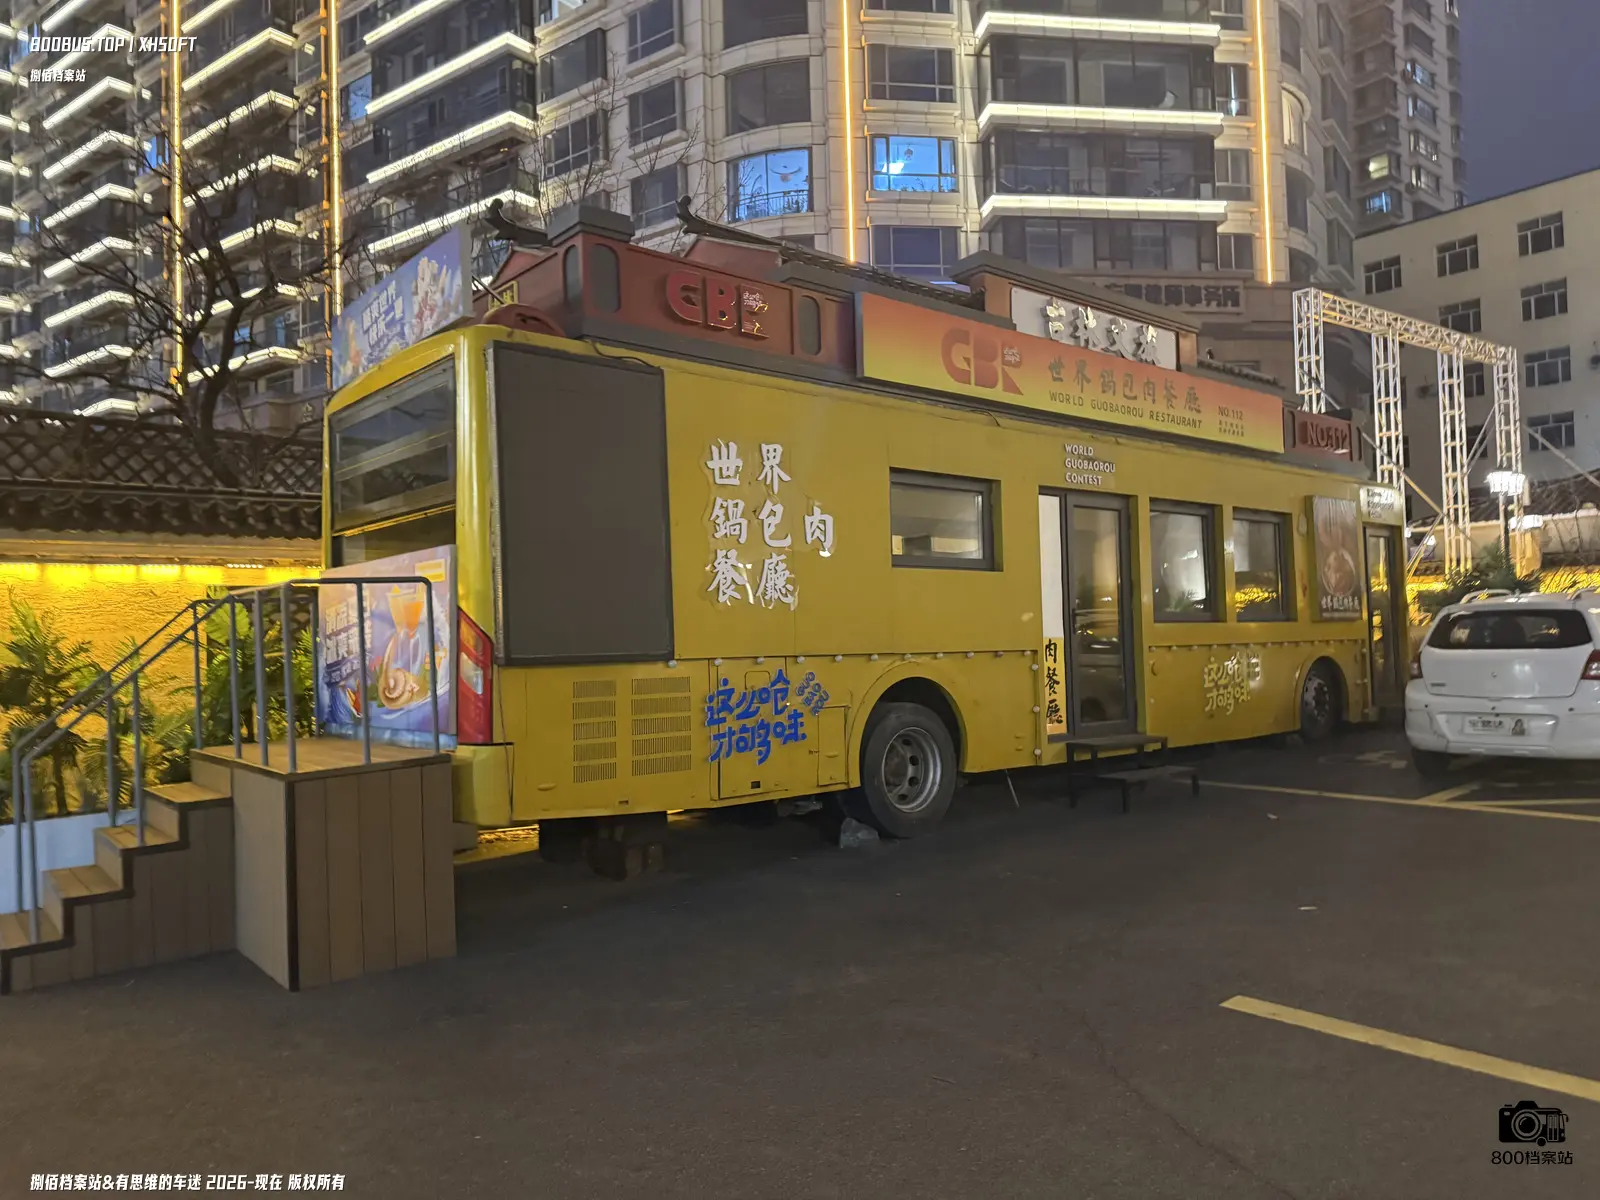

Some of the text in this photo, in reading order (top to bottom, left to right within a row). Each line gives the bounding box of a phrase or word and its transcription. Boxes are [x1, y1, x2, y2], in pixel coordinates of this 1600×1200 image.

[1104, 283, 1241, 308] 律师事务所
[941, 327, 1024, 396] GBR
[1049, 390, 1084, 407] WORLD
[1090, 400, 1144, 418] GUOBAOROU
[1149, 409, 1203, 429] RESTAURANT
[705, 441, 792, 495] 世界
[1064, 443, 1094, 456] WORLD
[1065, 458, 1116, 473] GUOBAOROU
[1065, 472, 1102, 486] CONTEST
[709, 496, 834, 553] 鍋包肉
[706, 549, 796, 605] 餐廳
[705, 669, 791, 727] 这么呛
[709, 709, 807, 766] 才够味
